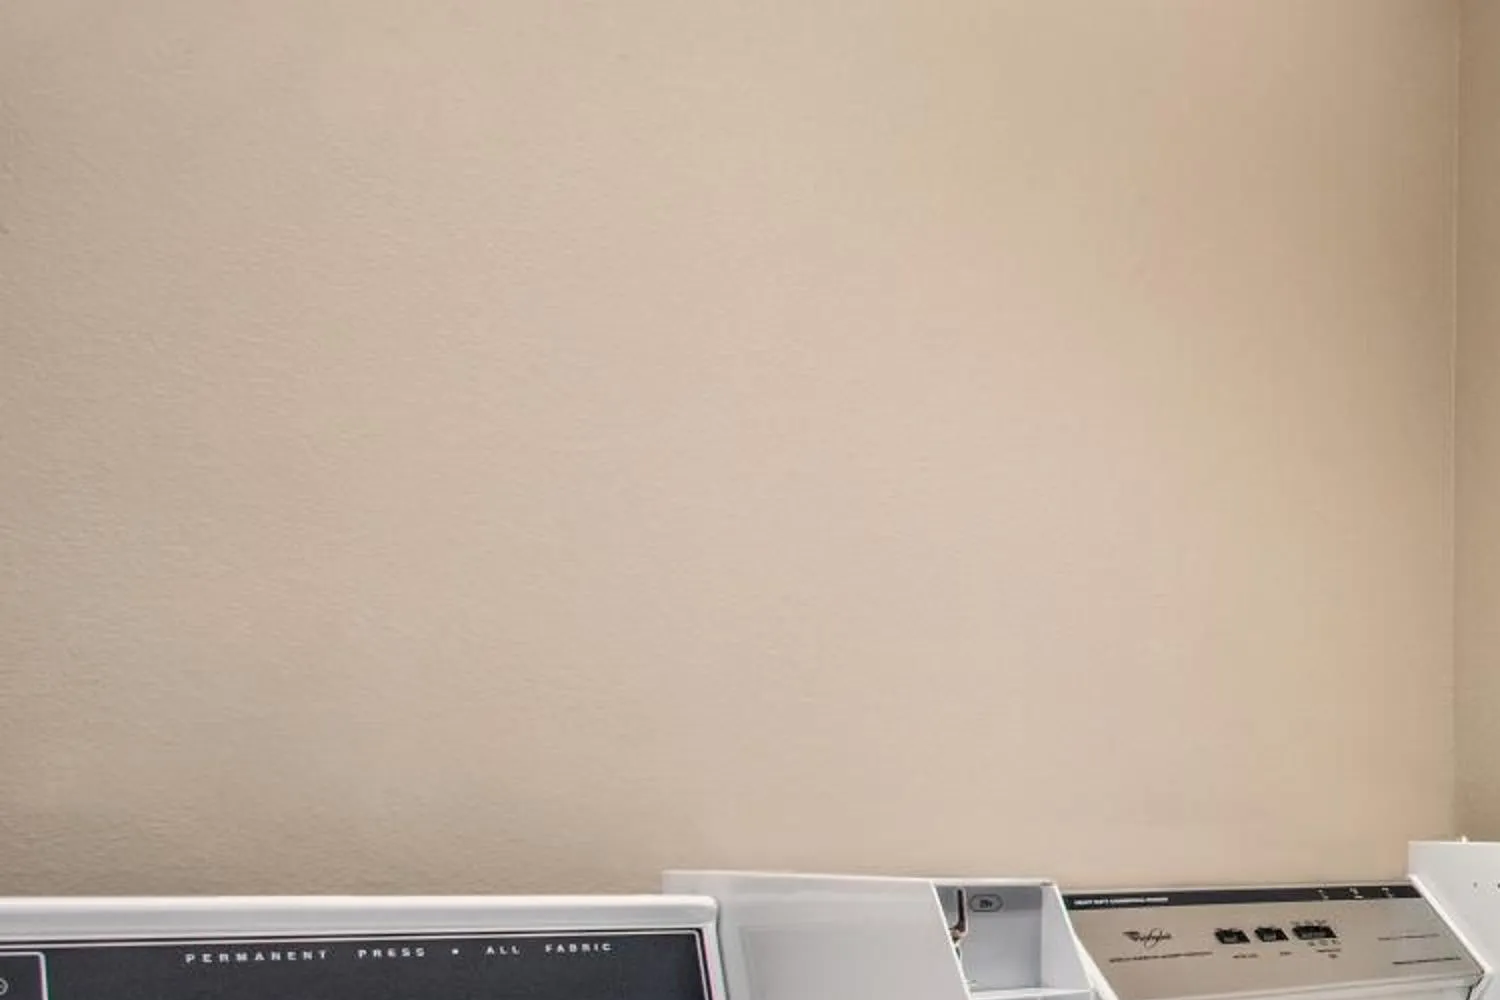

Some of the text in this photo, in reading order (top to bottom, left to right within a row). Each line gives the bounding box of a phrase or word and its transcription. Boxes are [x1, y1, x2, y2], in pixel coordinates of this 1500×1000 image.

[184, 943, 611, 963] PERMANENT PRESS ALL FABRIC
